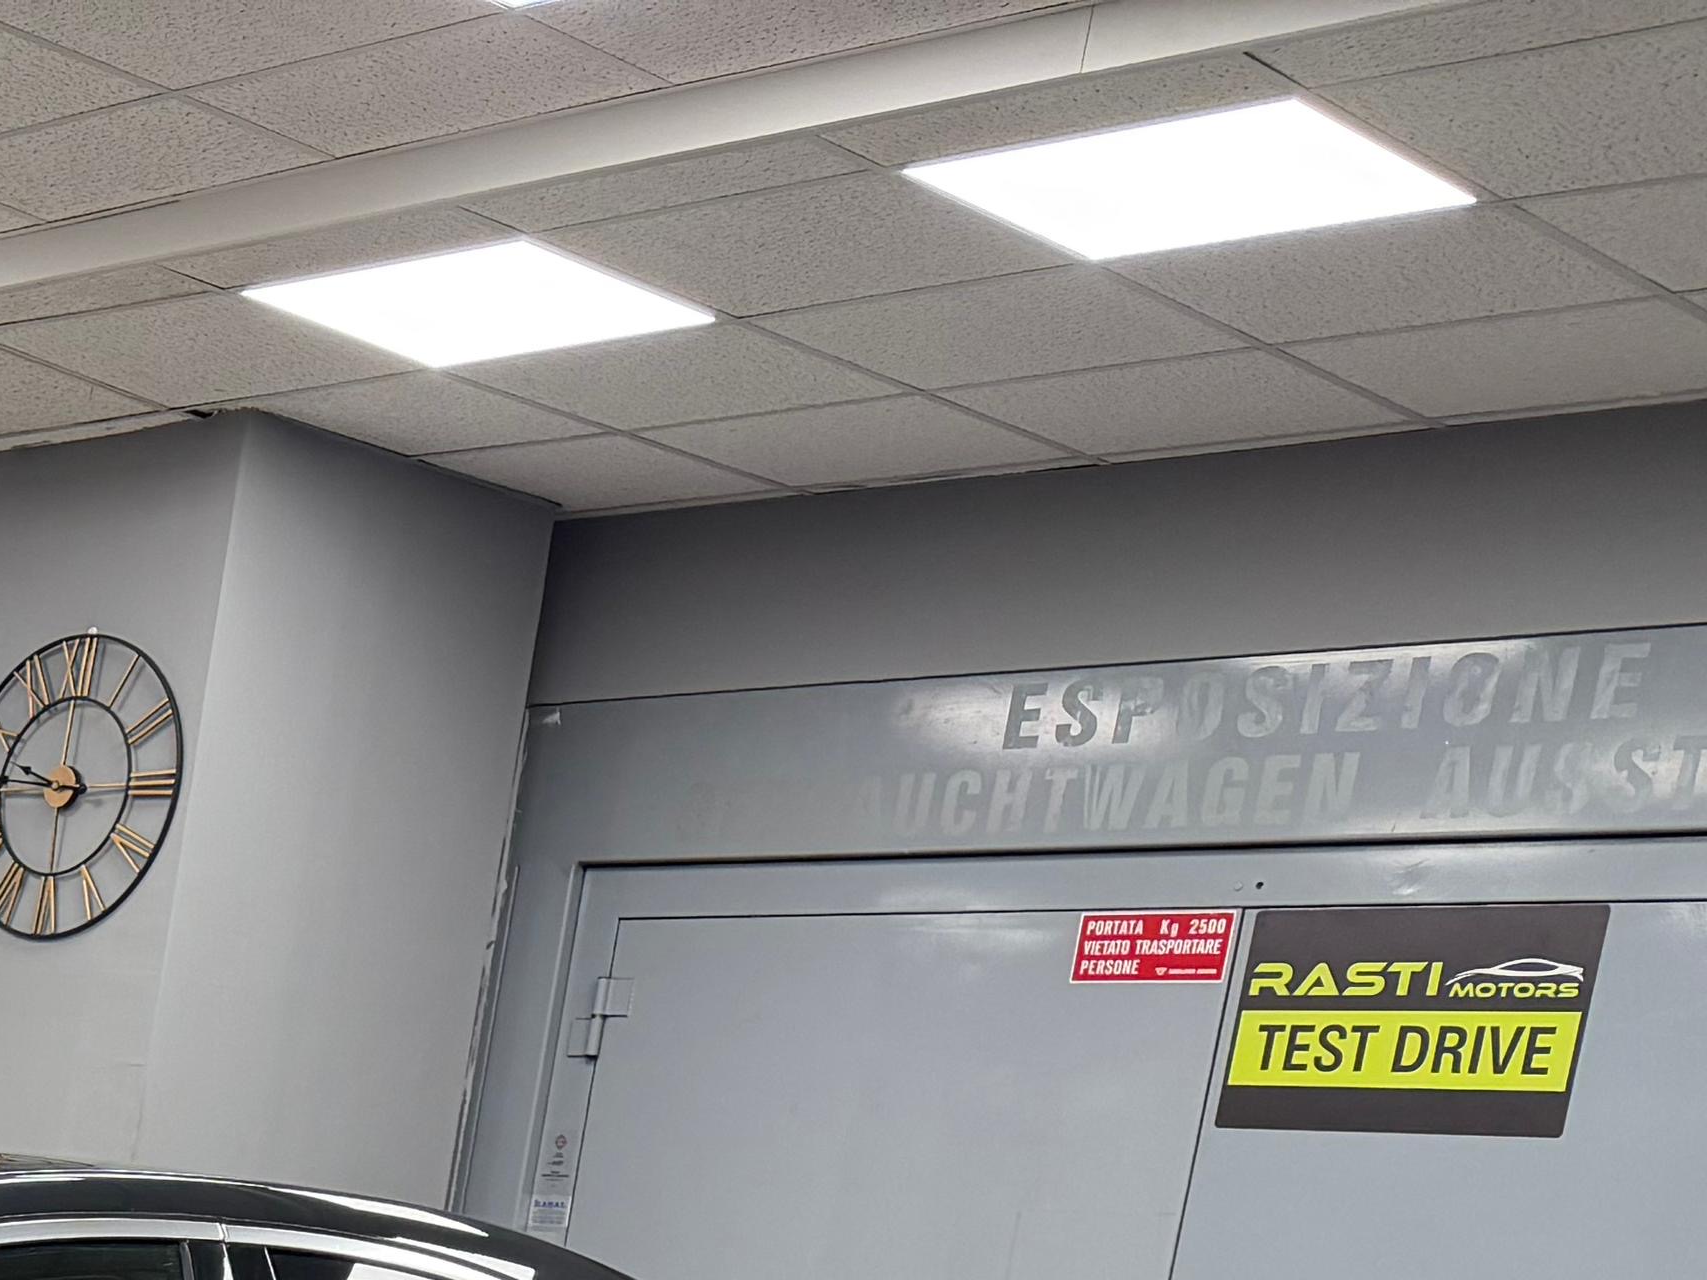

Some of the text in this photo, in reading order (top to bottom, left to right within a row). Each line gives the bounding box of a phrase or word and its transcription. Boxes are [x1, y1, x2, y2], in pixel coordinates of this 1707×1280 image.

[1001, 643, 1651, 751] ESPOSIZIONE
[1087, 918, 1227, 938] PORTATA Kg 2500
[1084, 939, 1223, 956] VIETATO TRASPORTARE
[1080, 959, 1140, 975] PERSONE
[1248, 961, 1579, 998] RASTI MOTORS
[1258, 1024, 1557, 1075] TEST DRIVE
